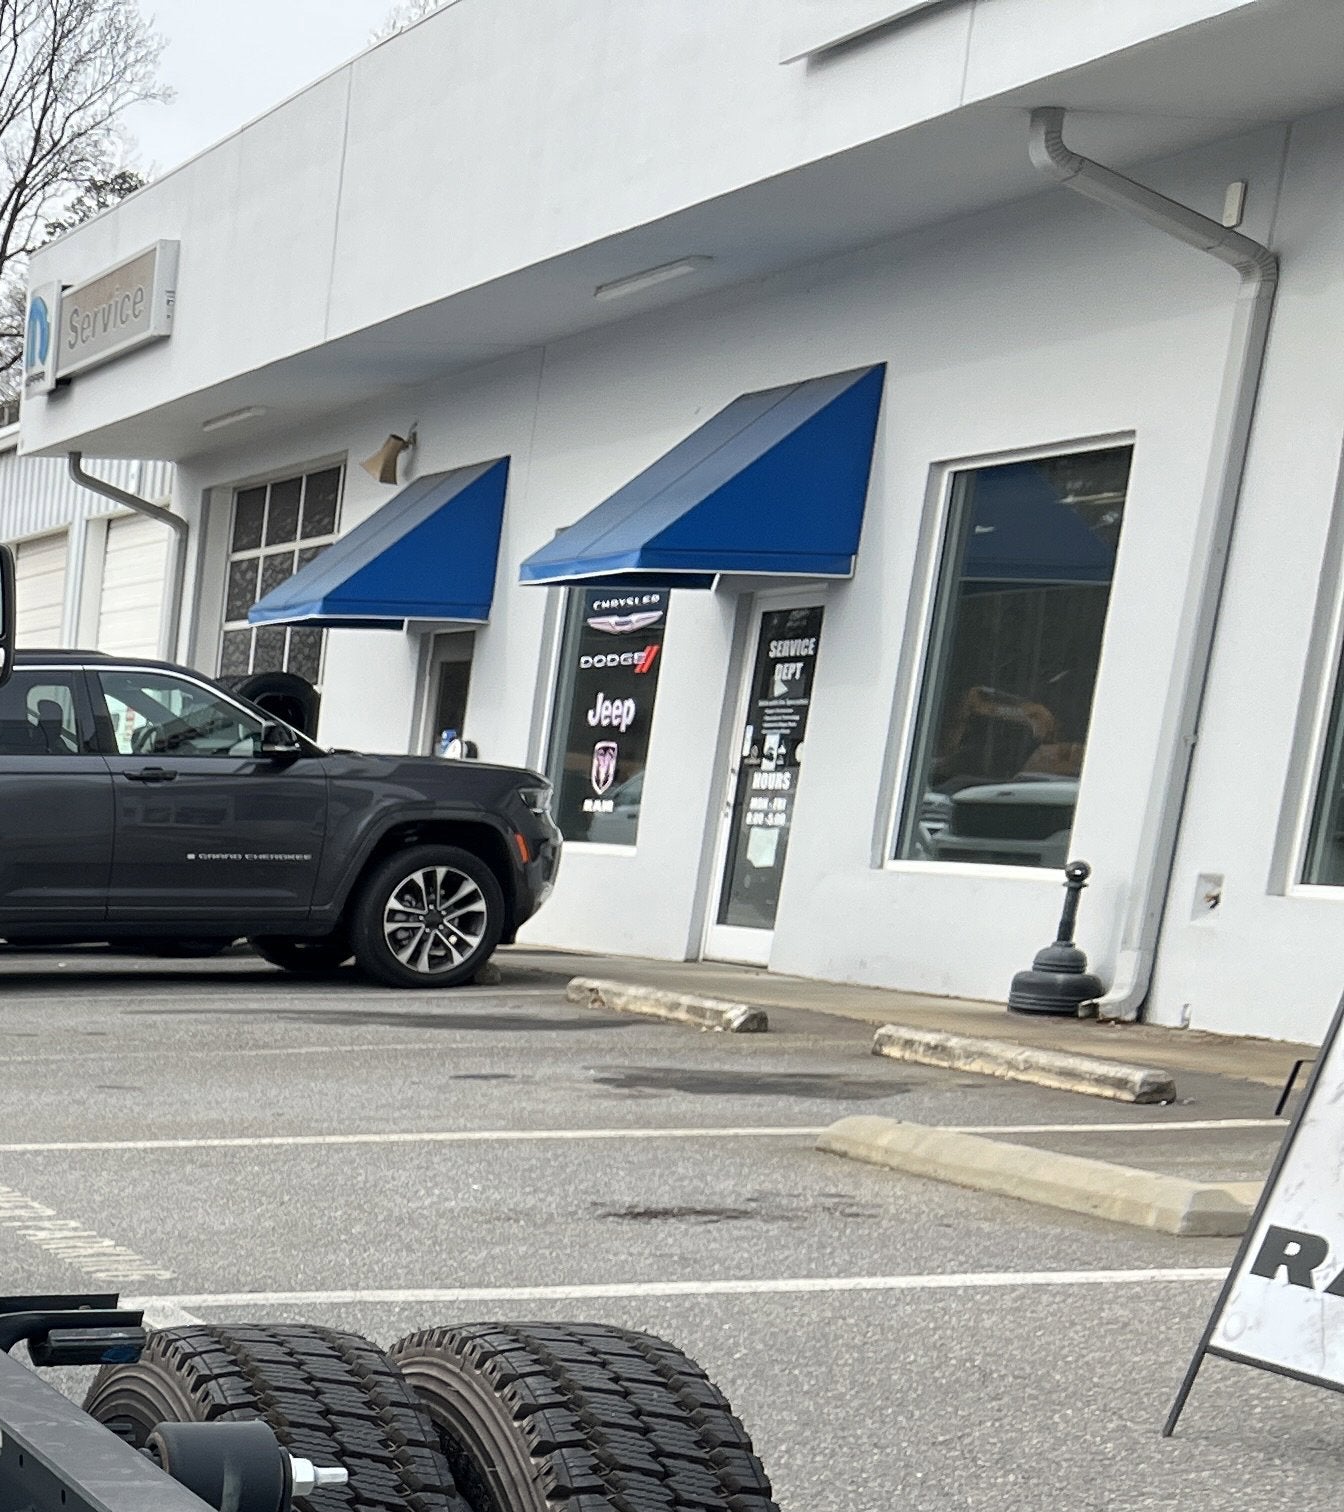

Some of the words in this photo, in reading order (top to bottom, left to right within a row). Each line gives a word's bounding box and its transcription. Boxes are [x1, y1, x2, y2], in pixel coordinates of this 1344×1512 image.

[69, 287, 143, 349] Service
[593, 594, 660, 610] CHRYSLER
[768, 638, 815, 658] SERVICE
[580, 651, 647, 669] DODGE
[774, 662, 803, 680] DEPT
[587, 692, 635, 732] Jeep
[752, 771, 791, 790] HOURS
